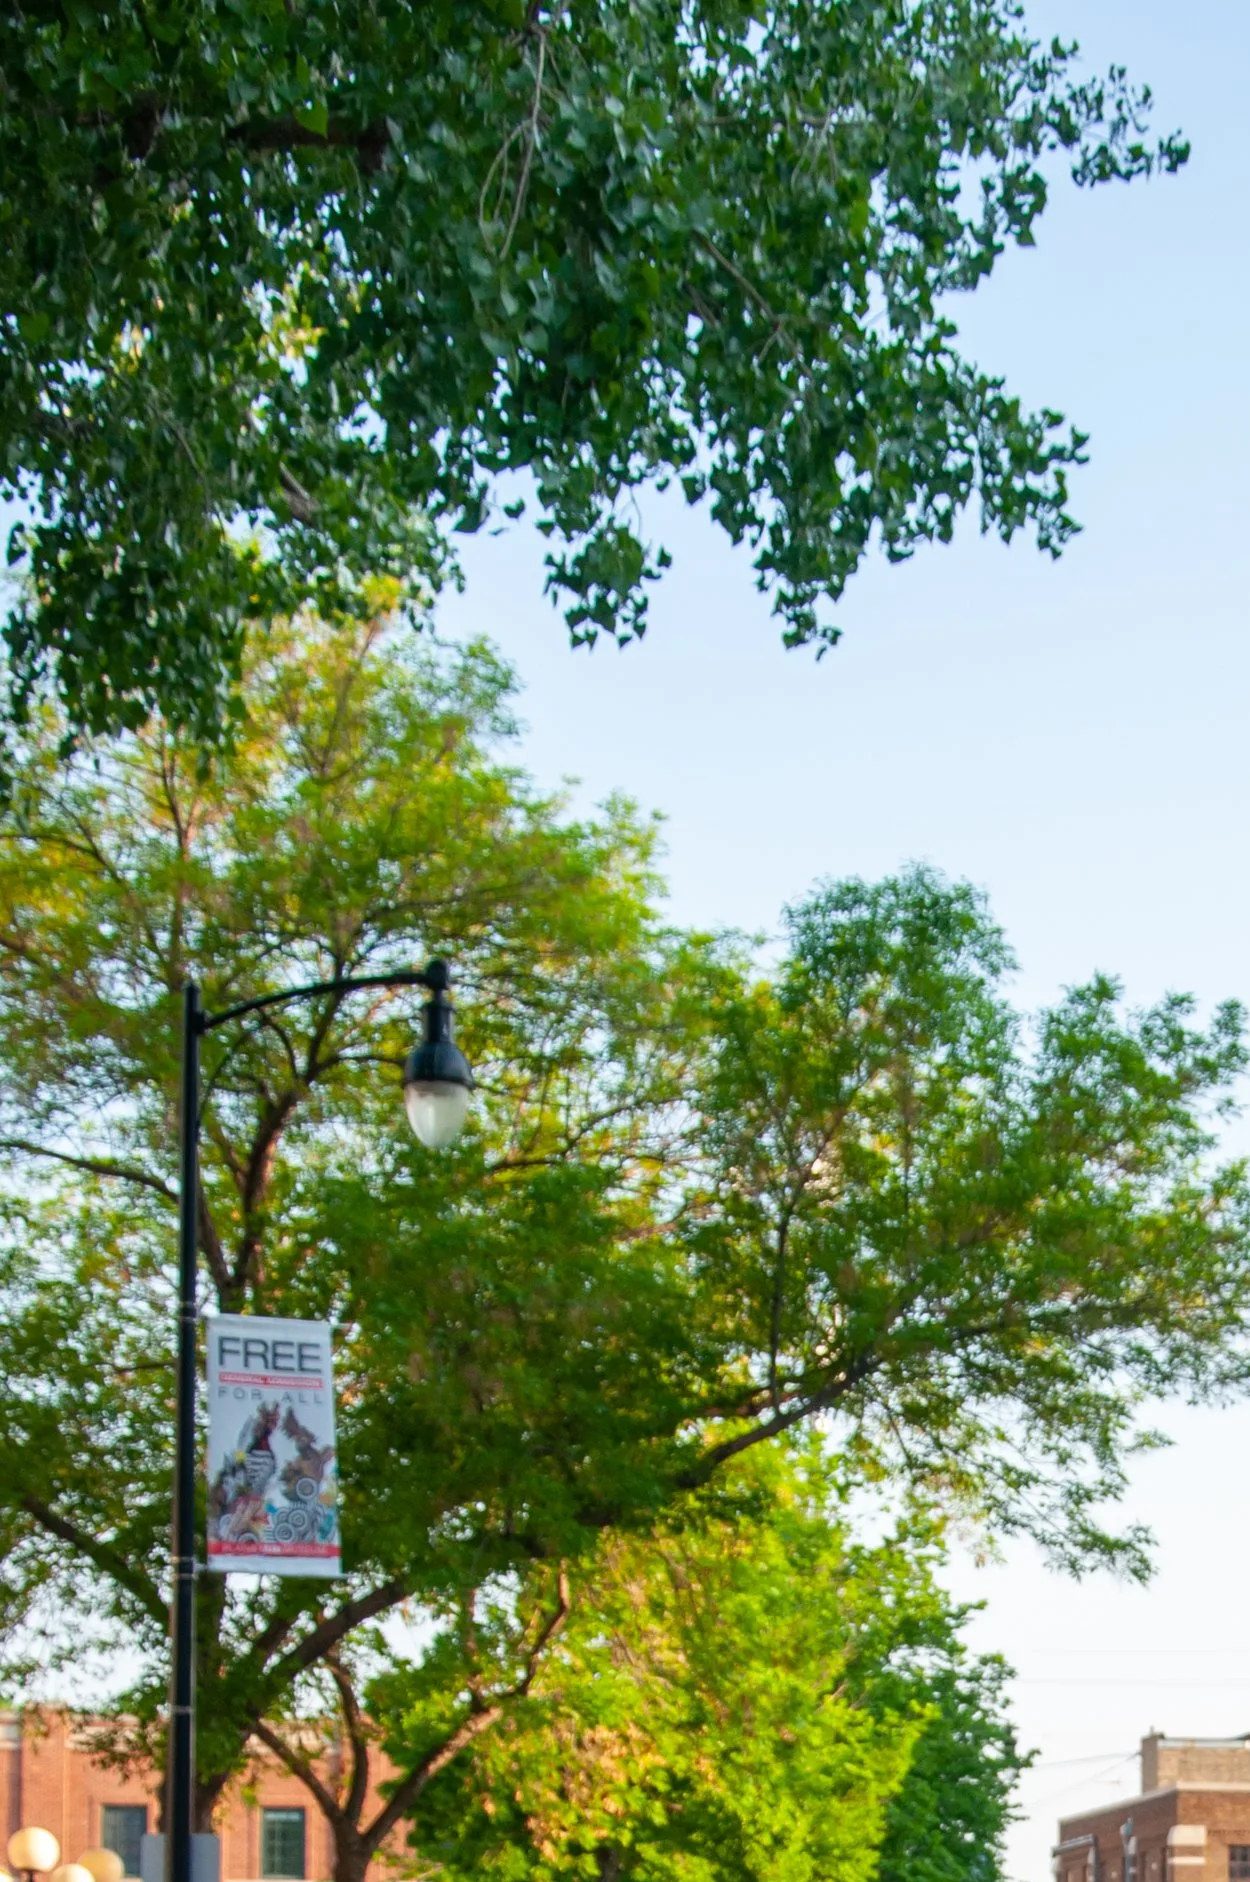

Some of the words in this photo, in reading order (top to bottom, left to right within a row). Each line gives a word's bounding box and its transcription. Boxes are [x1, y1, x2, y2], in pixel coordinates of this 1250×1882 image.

[218, 1335, 322, 1374] FREE
[218, 1385, 262, 1401] FOR
[281, 1390, 323, 1404] ALL
